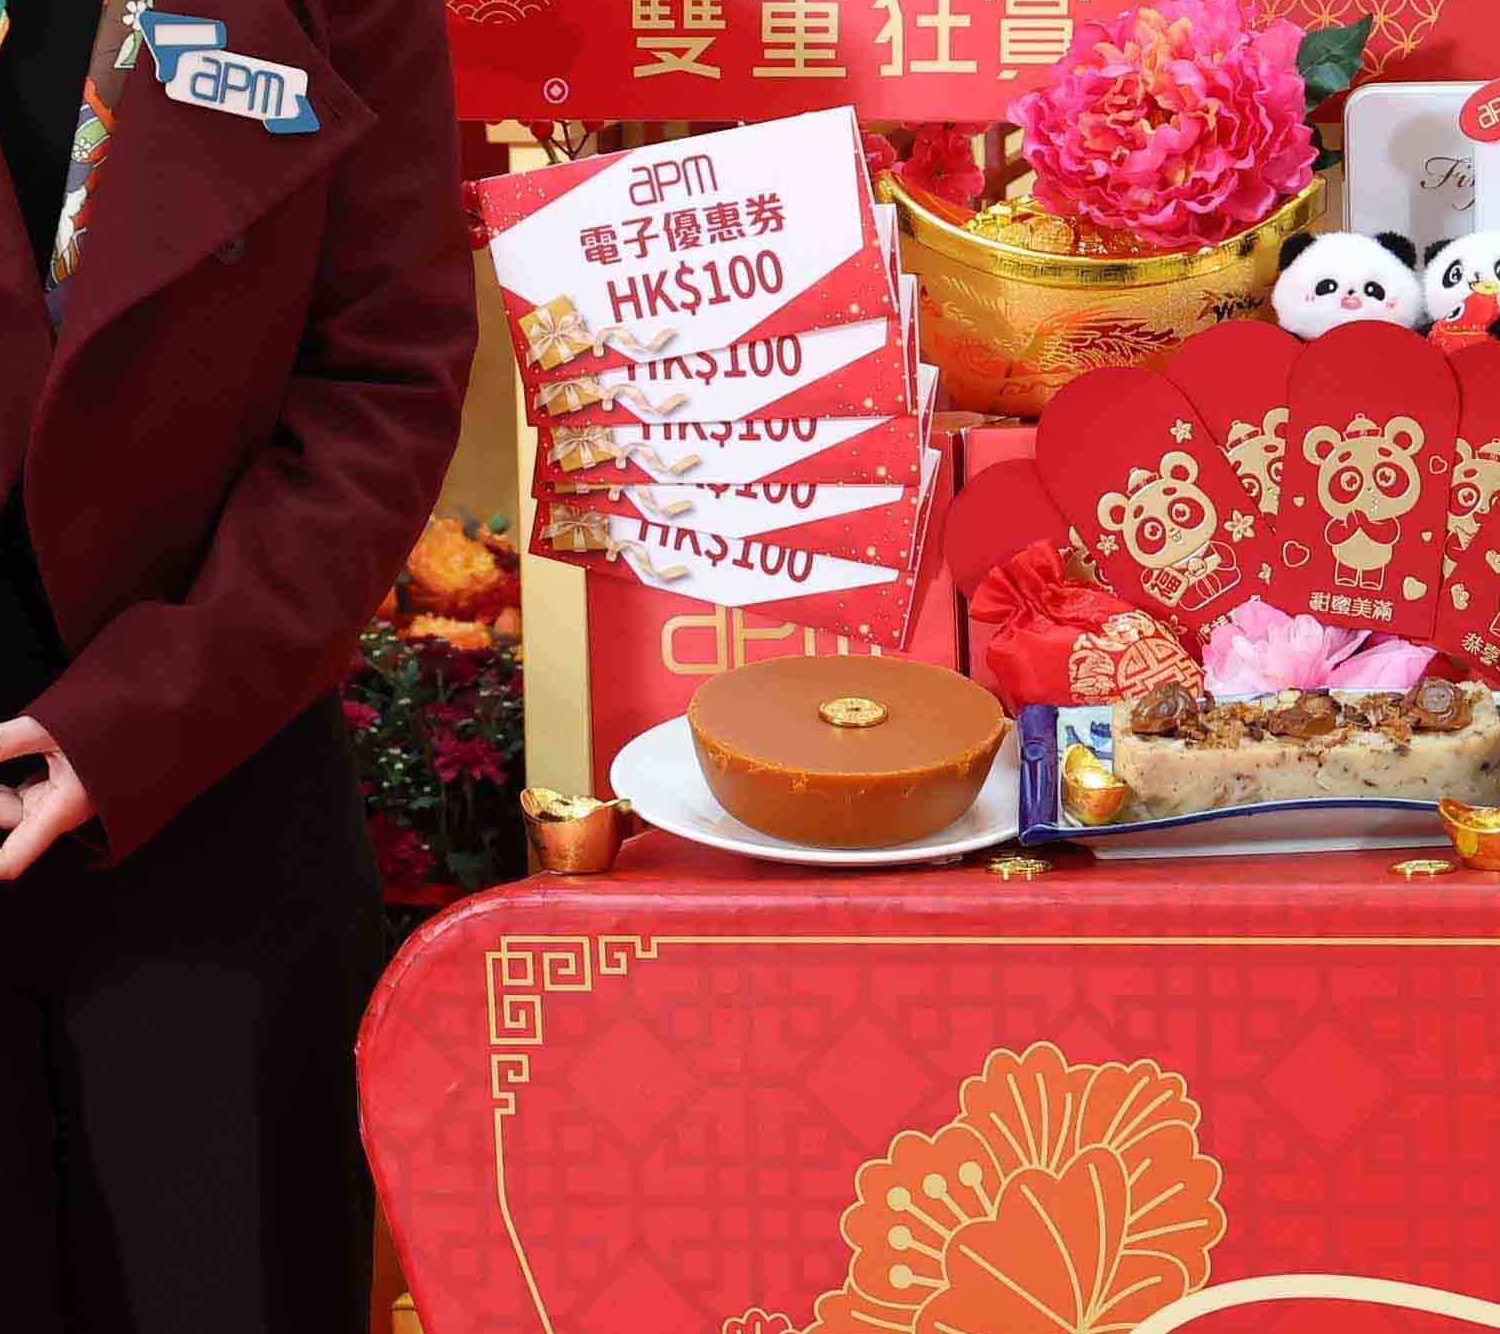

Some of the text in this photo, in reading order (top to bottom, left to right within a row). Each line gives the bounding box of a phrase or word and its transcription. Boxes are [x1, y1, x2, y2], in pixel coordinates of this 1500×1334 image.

[579, 192, 786, 265] 電子優惠券
[606, 249, 784, 323] HK$100
[1309, 591, 1394, 622] 甜蜜美滿
